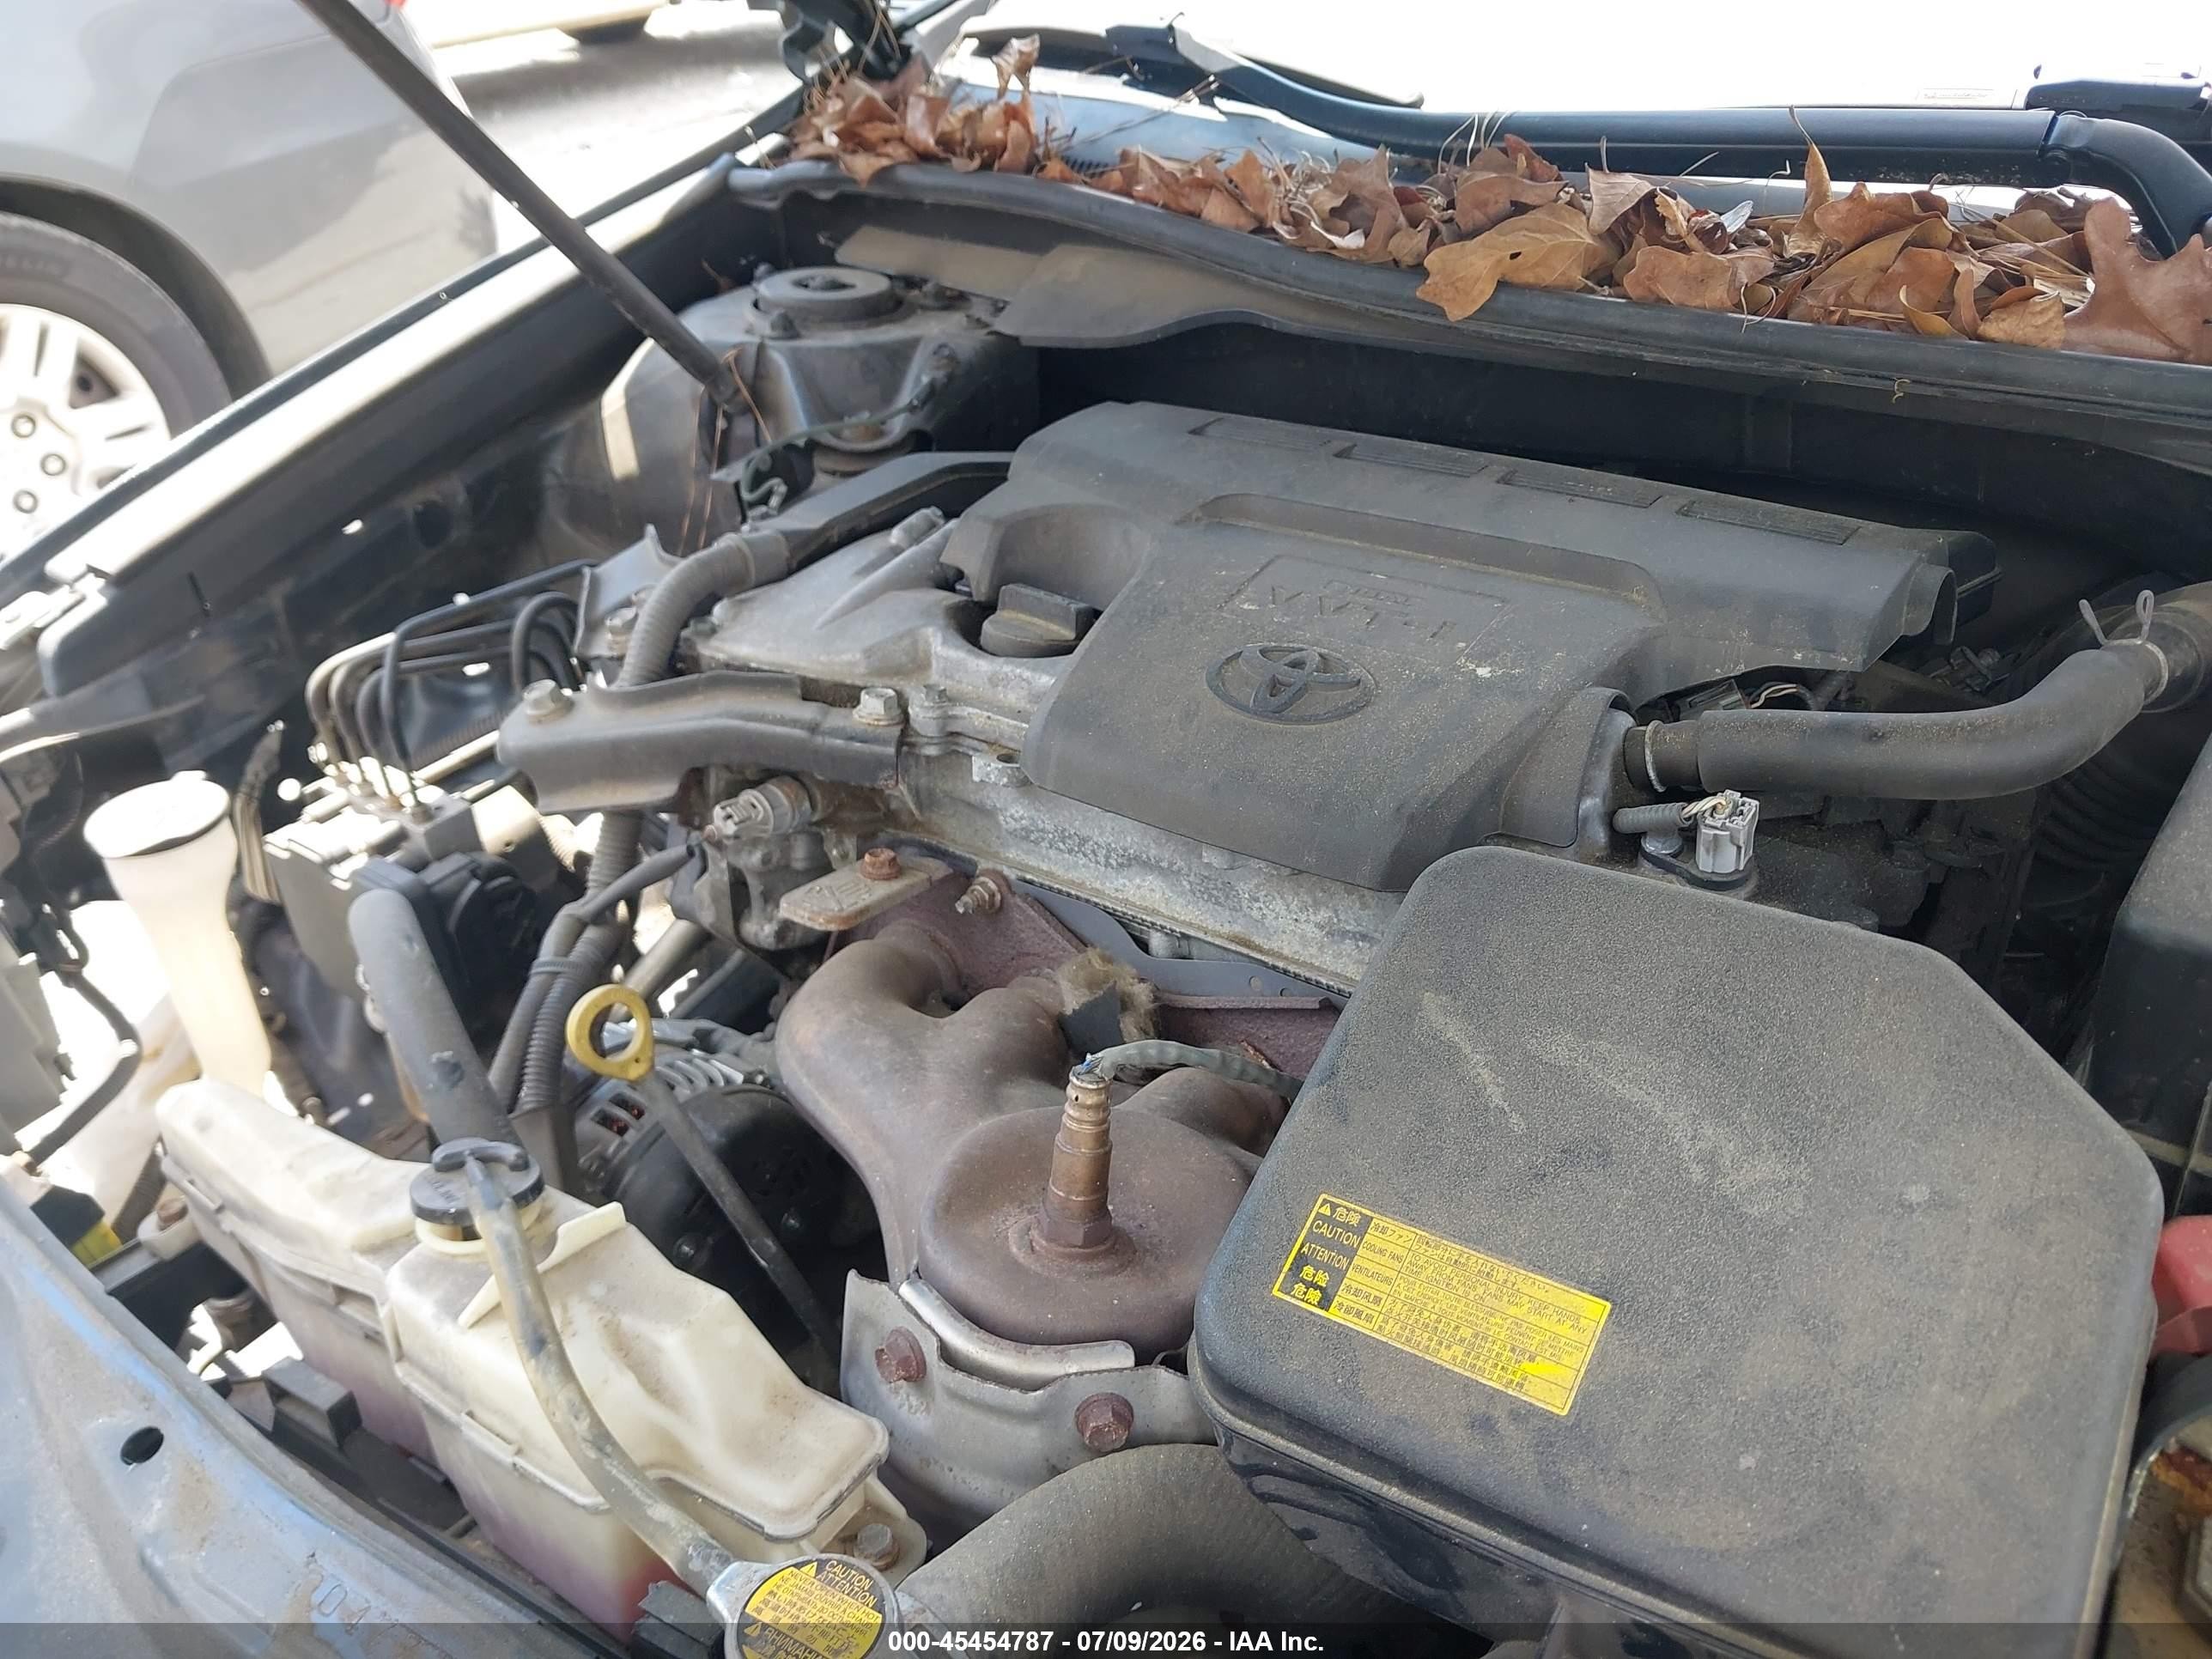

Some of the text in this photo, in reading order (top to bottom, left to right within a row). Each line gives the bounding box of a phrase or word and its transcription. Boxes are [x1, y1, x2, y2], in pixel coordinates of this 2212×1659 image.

[1310, 1218, 1361, 1248] CAUTION
[1300, 1241, 1350, 1270] ATTENTION
[1361, 1240, 1404, 1264] COOLING FANS
[1298, 1263, 1331, 1287] 危险
[1350, 1262, 1394, 1286] VENTILATEURS
[1403, 1266, 1422, 1278] TIME
[1425, 1273, 1459, 1292] IGNITION
[1462, 1288, 1471, 1297] IS
[1410, 1253, 1421, 1261] TO
[1424, 1258, 1448, 1272] AVOID
[1449, 1267, 1491, 1289] PERSONAL
[1289, 1280, 1323, 1305] 危險
[1406, 1259, 1428, 1273] AWAY
[1430, 1268, 1455, 1283] FROM
[1482, 1288, 1504, 1302] FANS
[1505, 1297, 1524, 1310] MAY
[1526, 1305, 1552, 1321] START
[1555, 1316, 1565, 1326] AT
[1569, 1322, 1587, 1334] ANY
[815, 1567, 878, 1609] ATTENTION
[824, 1557, 874, 1591] CAUTION
[787, 1569, 815, 1588] NEVER
[813, 1583, 837, 1600] OPEN
[836, 1595, 862, 1613] WHEN
[789, 1579, 815, 1598] JAMAIS
[813, 1592, 842, 1612] OUVRIR
